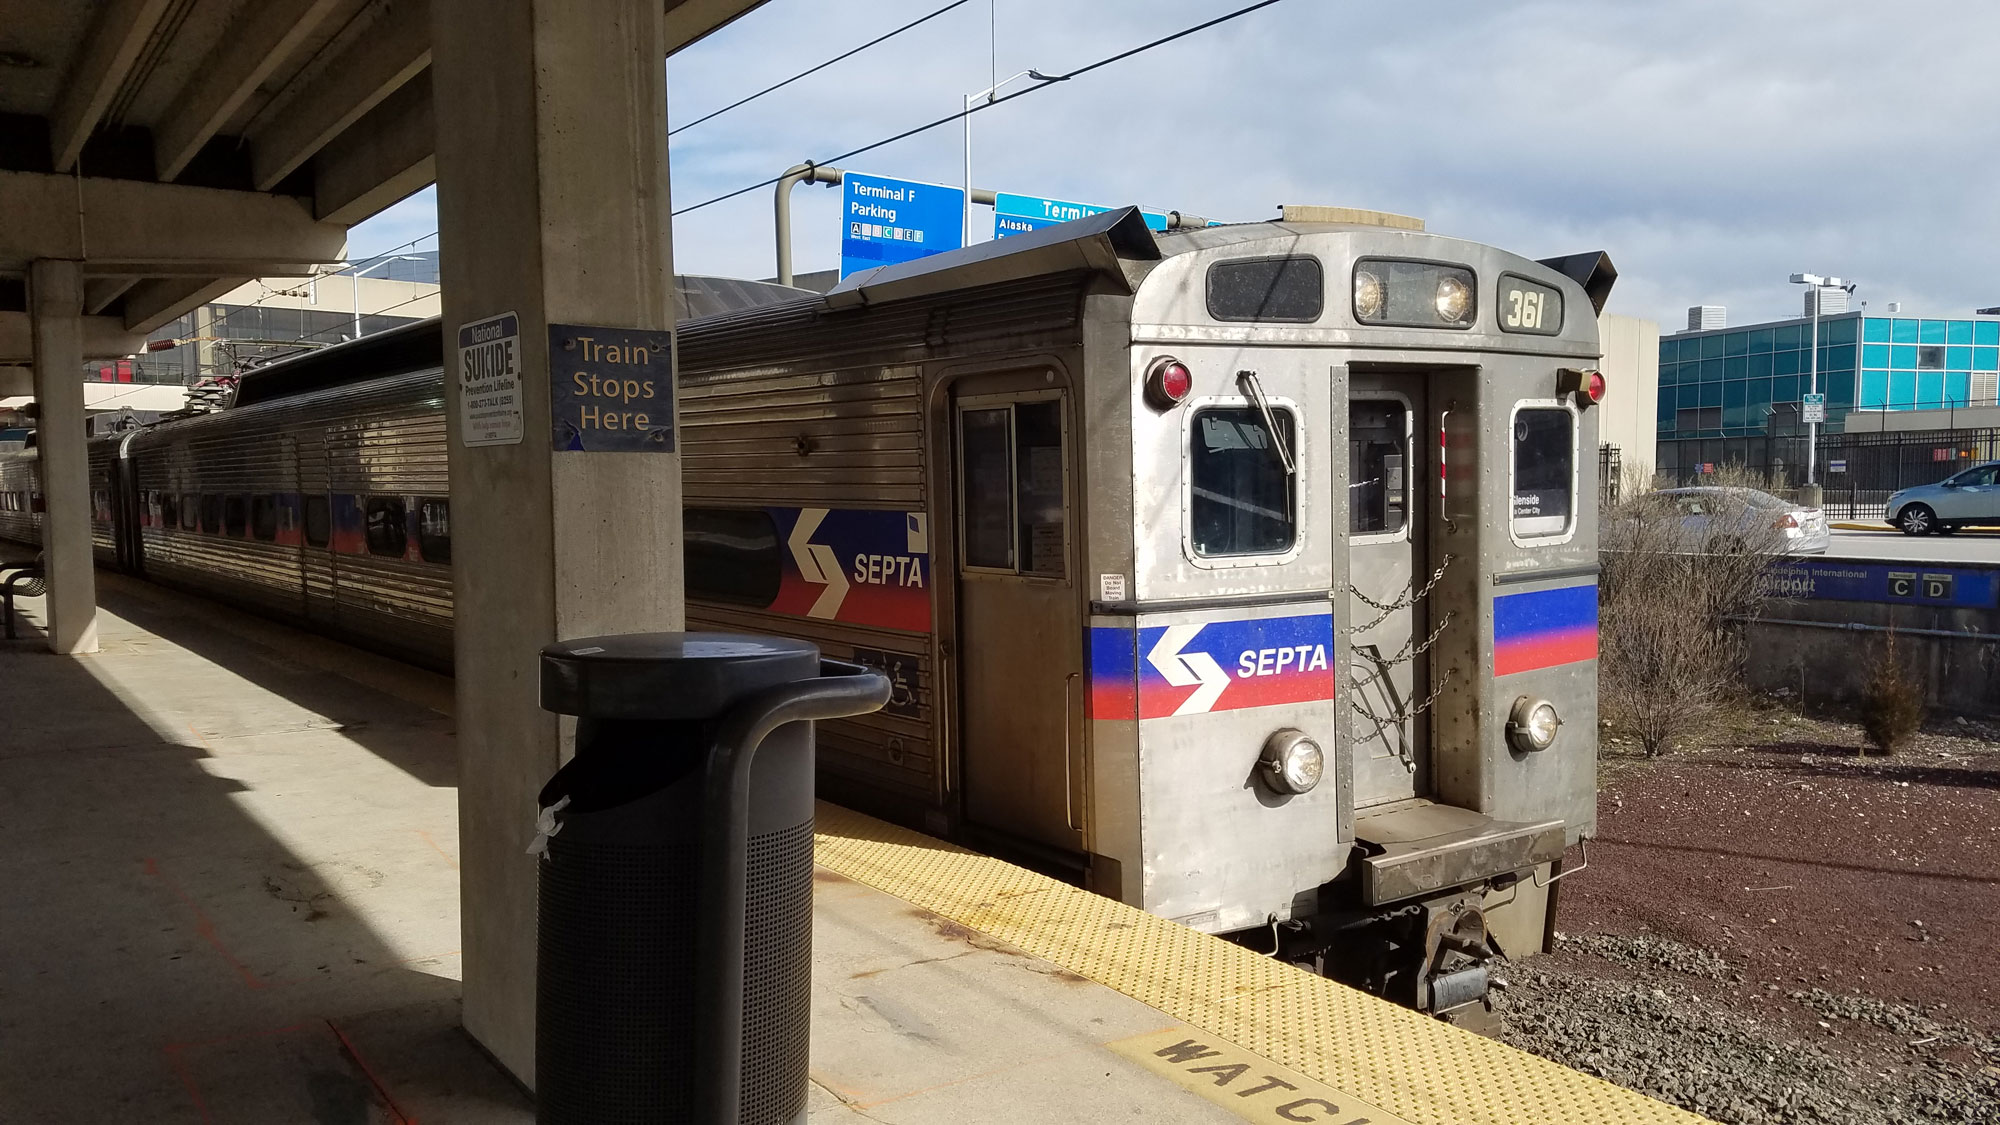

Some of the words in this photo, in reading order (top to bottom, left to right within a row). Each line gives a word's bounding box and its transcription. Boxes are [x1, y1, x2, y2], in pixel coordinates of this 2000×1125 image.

[852, 181, 904, 201] Terminal
[908, 190, 916, 202] F
[851, 201, 896, 223] Parking
[1042, 201, 1103, 220] Termin
[999, 218, 1033, 232] Alaska
[1507, 290, 1545, 329] 361
[471, 320, 503, 344] National
[464, 341, 514, 382] SUICIDE
[577, 337, 649, 365] Train
[465, 383, 493, 396] Prevention
[494, 379, 514, 392] Lifeline
[573, 371, 655, 404] Stops
[580, 405, 650, 431] Here
[854, 554, 923, 588] SEPTA
[1812, 568, 1867, 579] International
[1894, 580, 1909, 596] C
[1929, 582, 1944, 597] D
[1237, 644, 1328, 679] SEPTA
[1153, 1039, 1372, 1125] WATC
